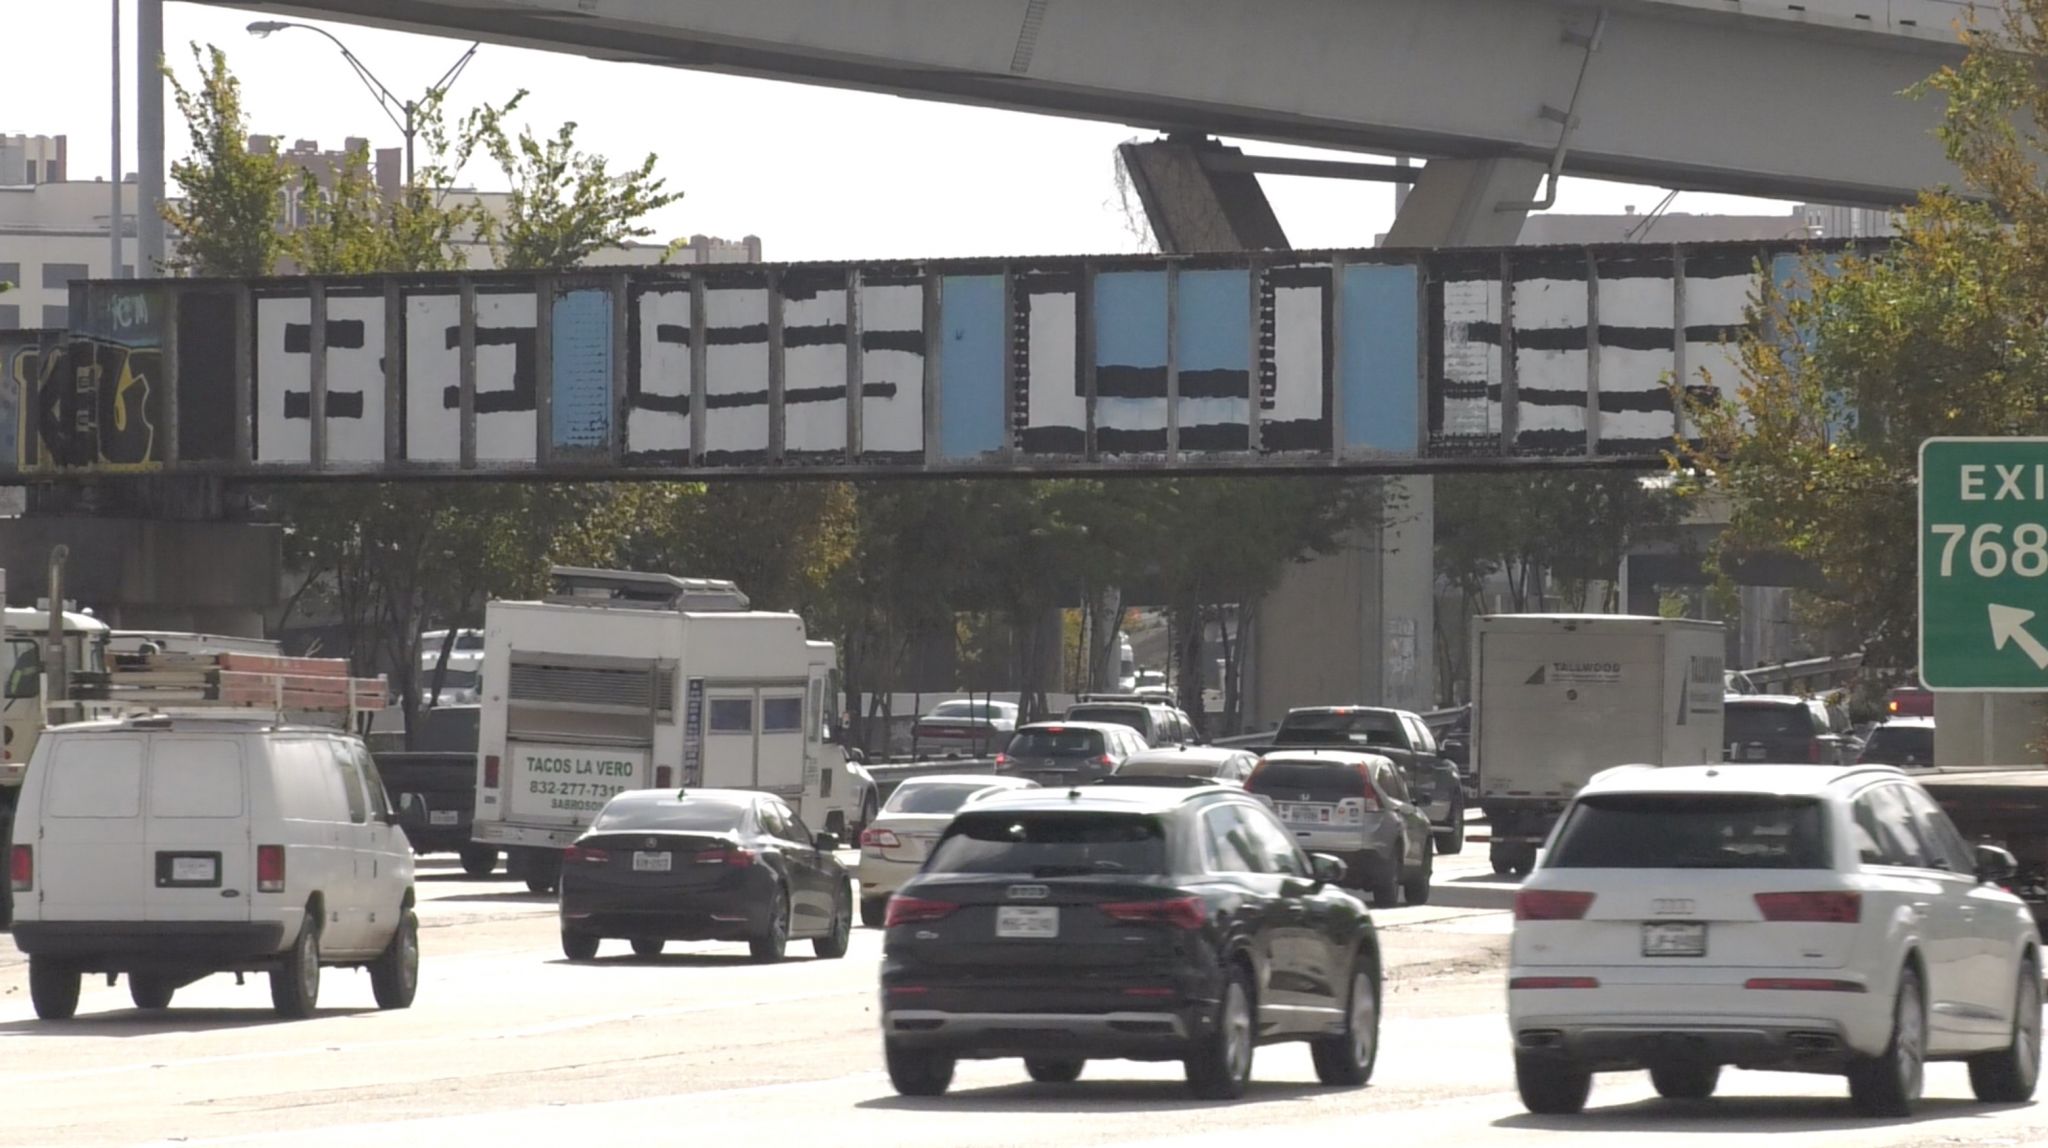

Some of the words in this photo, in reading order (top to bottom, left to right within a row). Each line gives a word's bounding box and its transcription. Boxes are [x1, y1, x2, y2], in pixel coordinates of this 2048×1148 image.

[1931, 523, 2048, 577] 768
[1553, 662, 1621, 674] TALLWOOD
[526, 757, 572, 774] TACOS
[576, 759, 593, 775] LA
[596, 761, 633, 777] VERO
